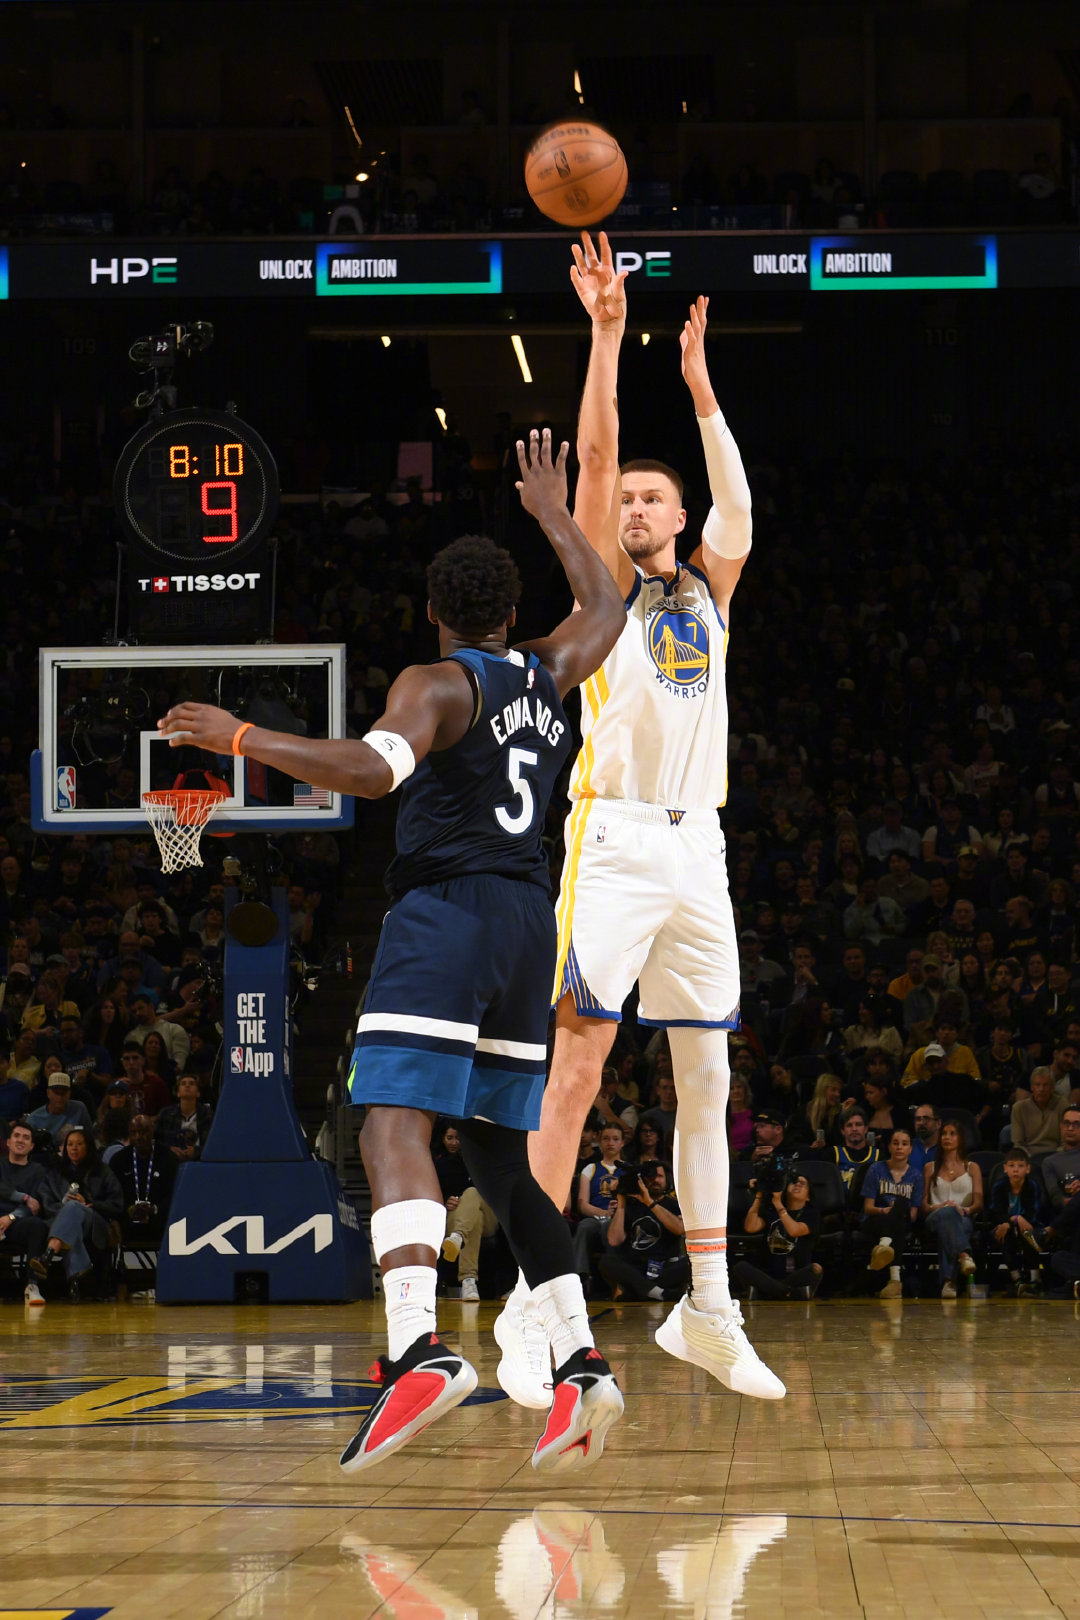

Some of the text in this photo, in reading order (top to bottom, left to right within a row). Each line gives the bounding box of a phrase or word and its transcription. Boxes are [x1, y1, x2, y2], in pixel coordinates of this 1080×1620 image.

[90, 257, 178, 285] HPE
[259, 258, 398, 280] UNLOCK AMBITION
[753, 252, 892, 275] UNLOCK AMBITION
[169, 443, 244, 478] 8:10
[200, 480, 239, 543] 9
[171, 572, 261, 593] TISSOT
[686, 621, 698, 643] 7
[655, 668, 711, 700] WARRIO
[494, 747, 538, 835] 5
[236, 992, 266, 1018] GET
[236, 1019, 267, 1044] THE
[244, 1046, 275, 1078] App
[168, 1213, 334, 1256] KIA
